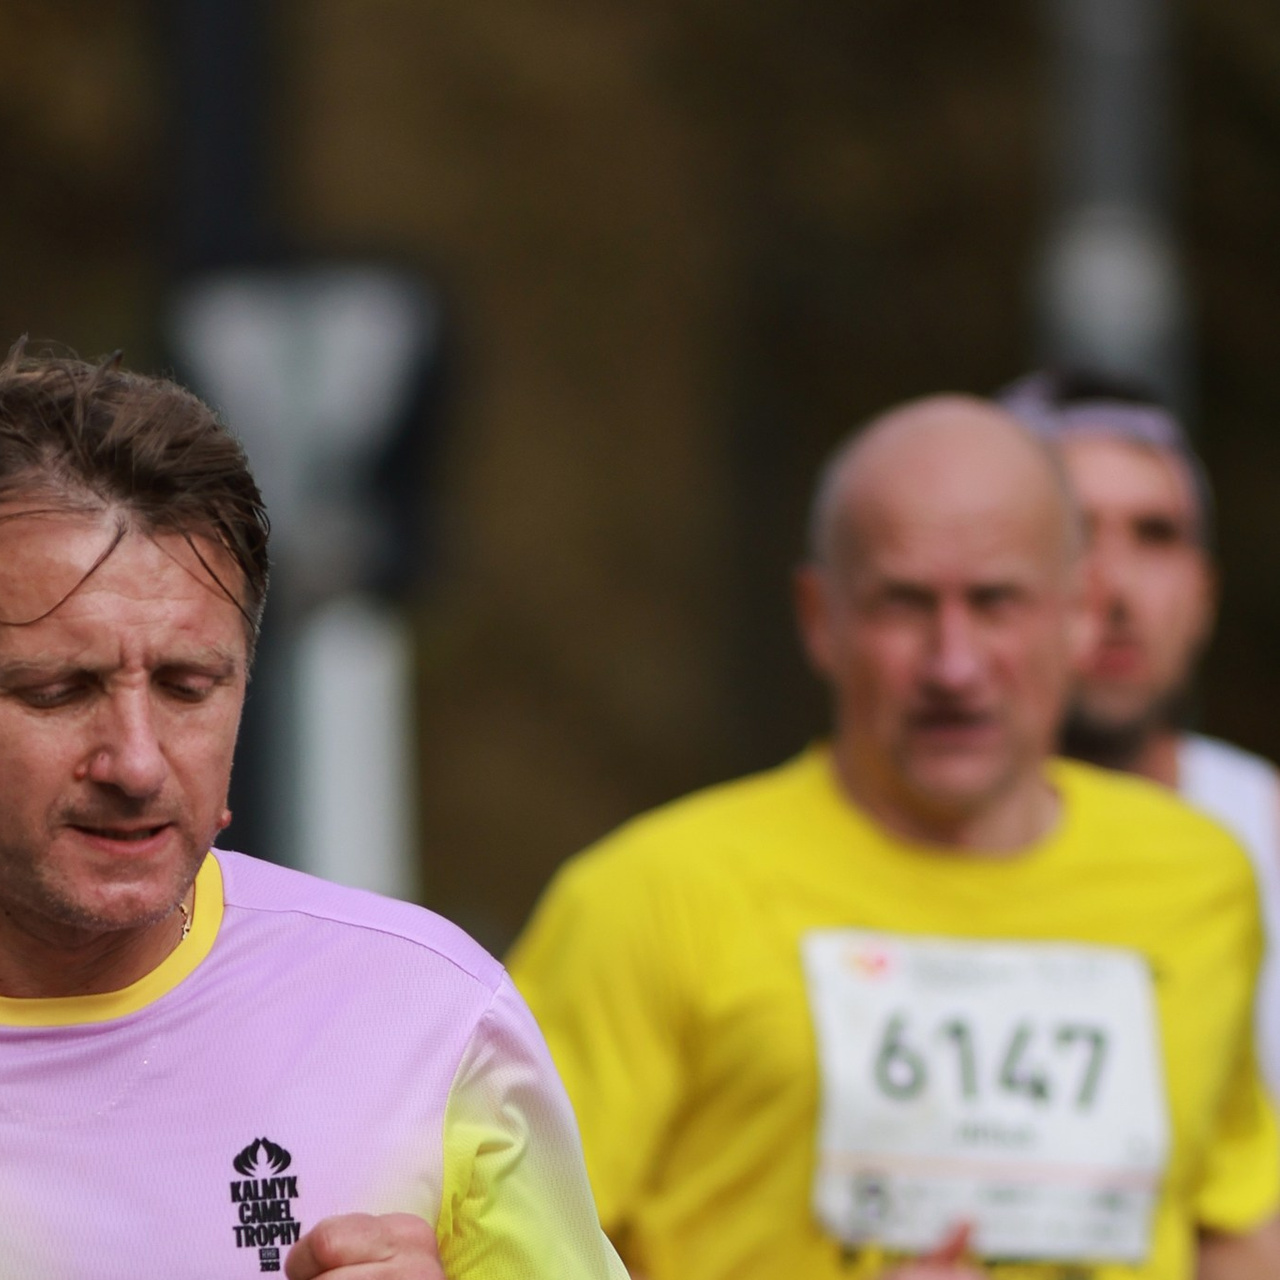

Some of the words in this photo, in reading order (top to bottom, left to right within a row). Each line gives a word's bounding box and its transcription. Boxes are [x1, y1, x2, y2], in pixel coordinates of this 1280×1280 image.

[873, 1008, 1110, 1114] 6147
[230, 1176, 299, 1203] KALMYK
[238, 1200, 295, 1225] CAMEL
[232, 1221, 301, 1248] TROPHY
